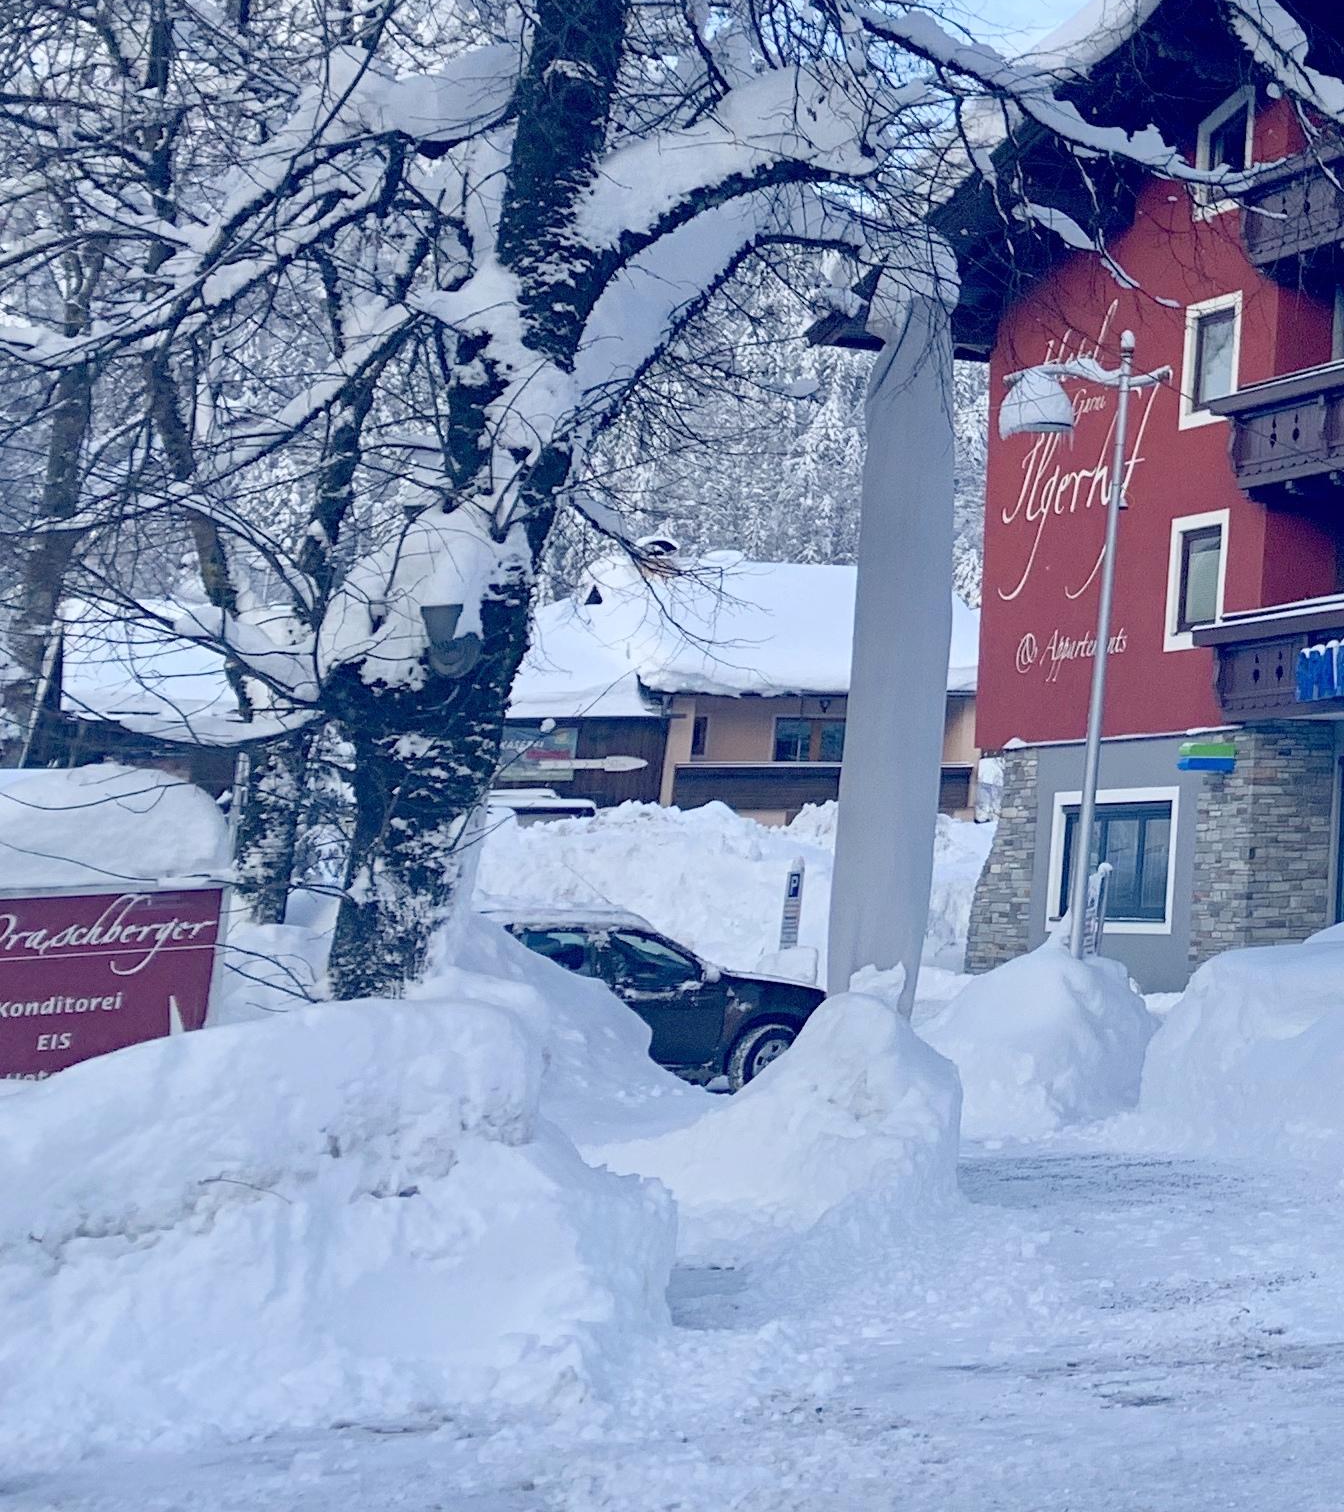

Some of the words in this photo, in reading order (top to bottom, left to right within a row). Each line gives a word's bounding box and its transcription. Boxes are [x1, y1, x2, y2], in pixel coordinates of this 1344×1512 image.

[997, 368, 1173, 601] Ilgerhf
[0, 991, 123, 1018] Konditorei
[36, 1032, 73, 1051] EIS
